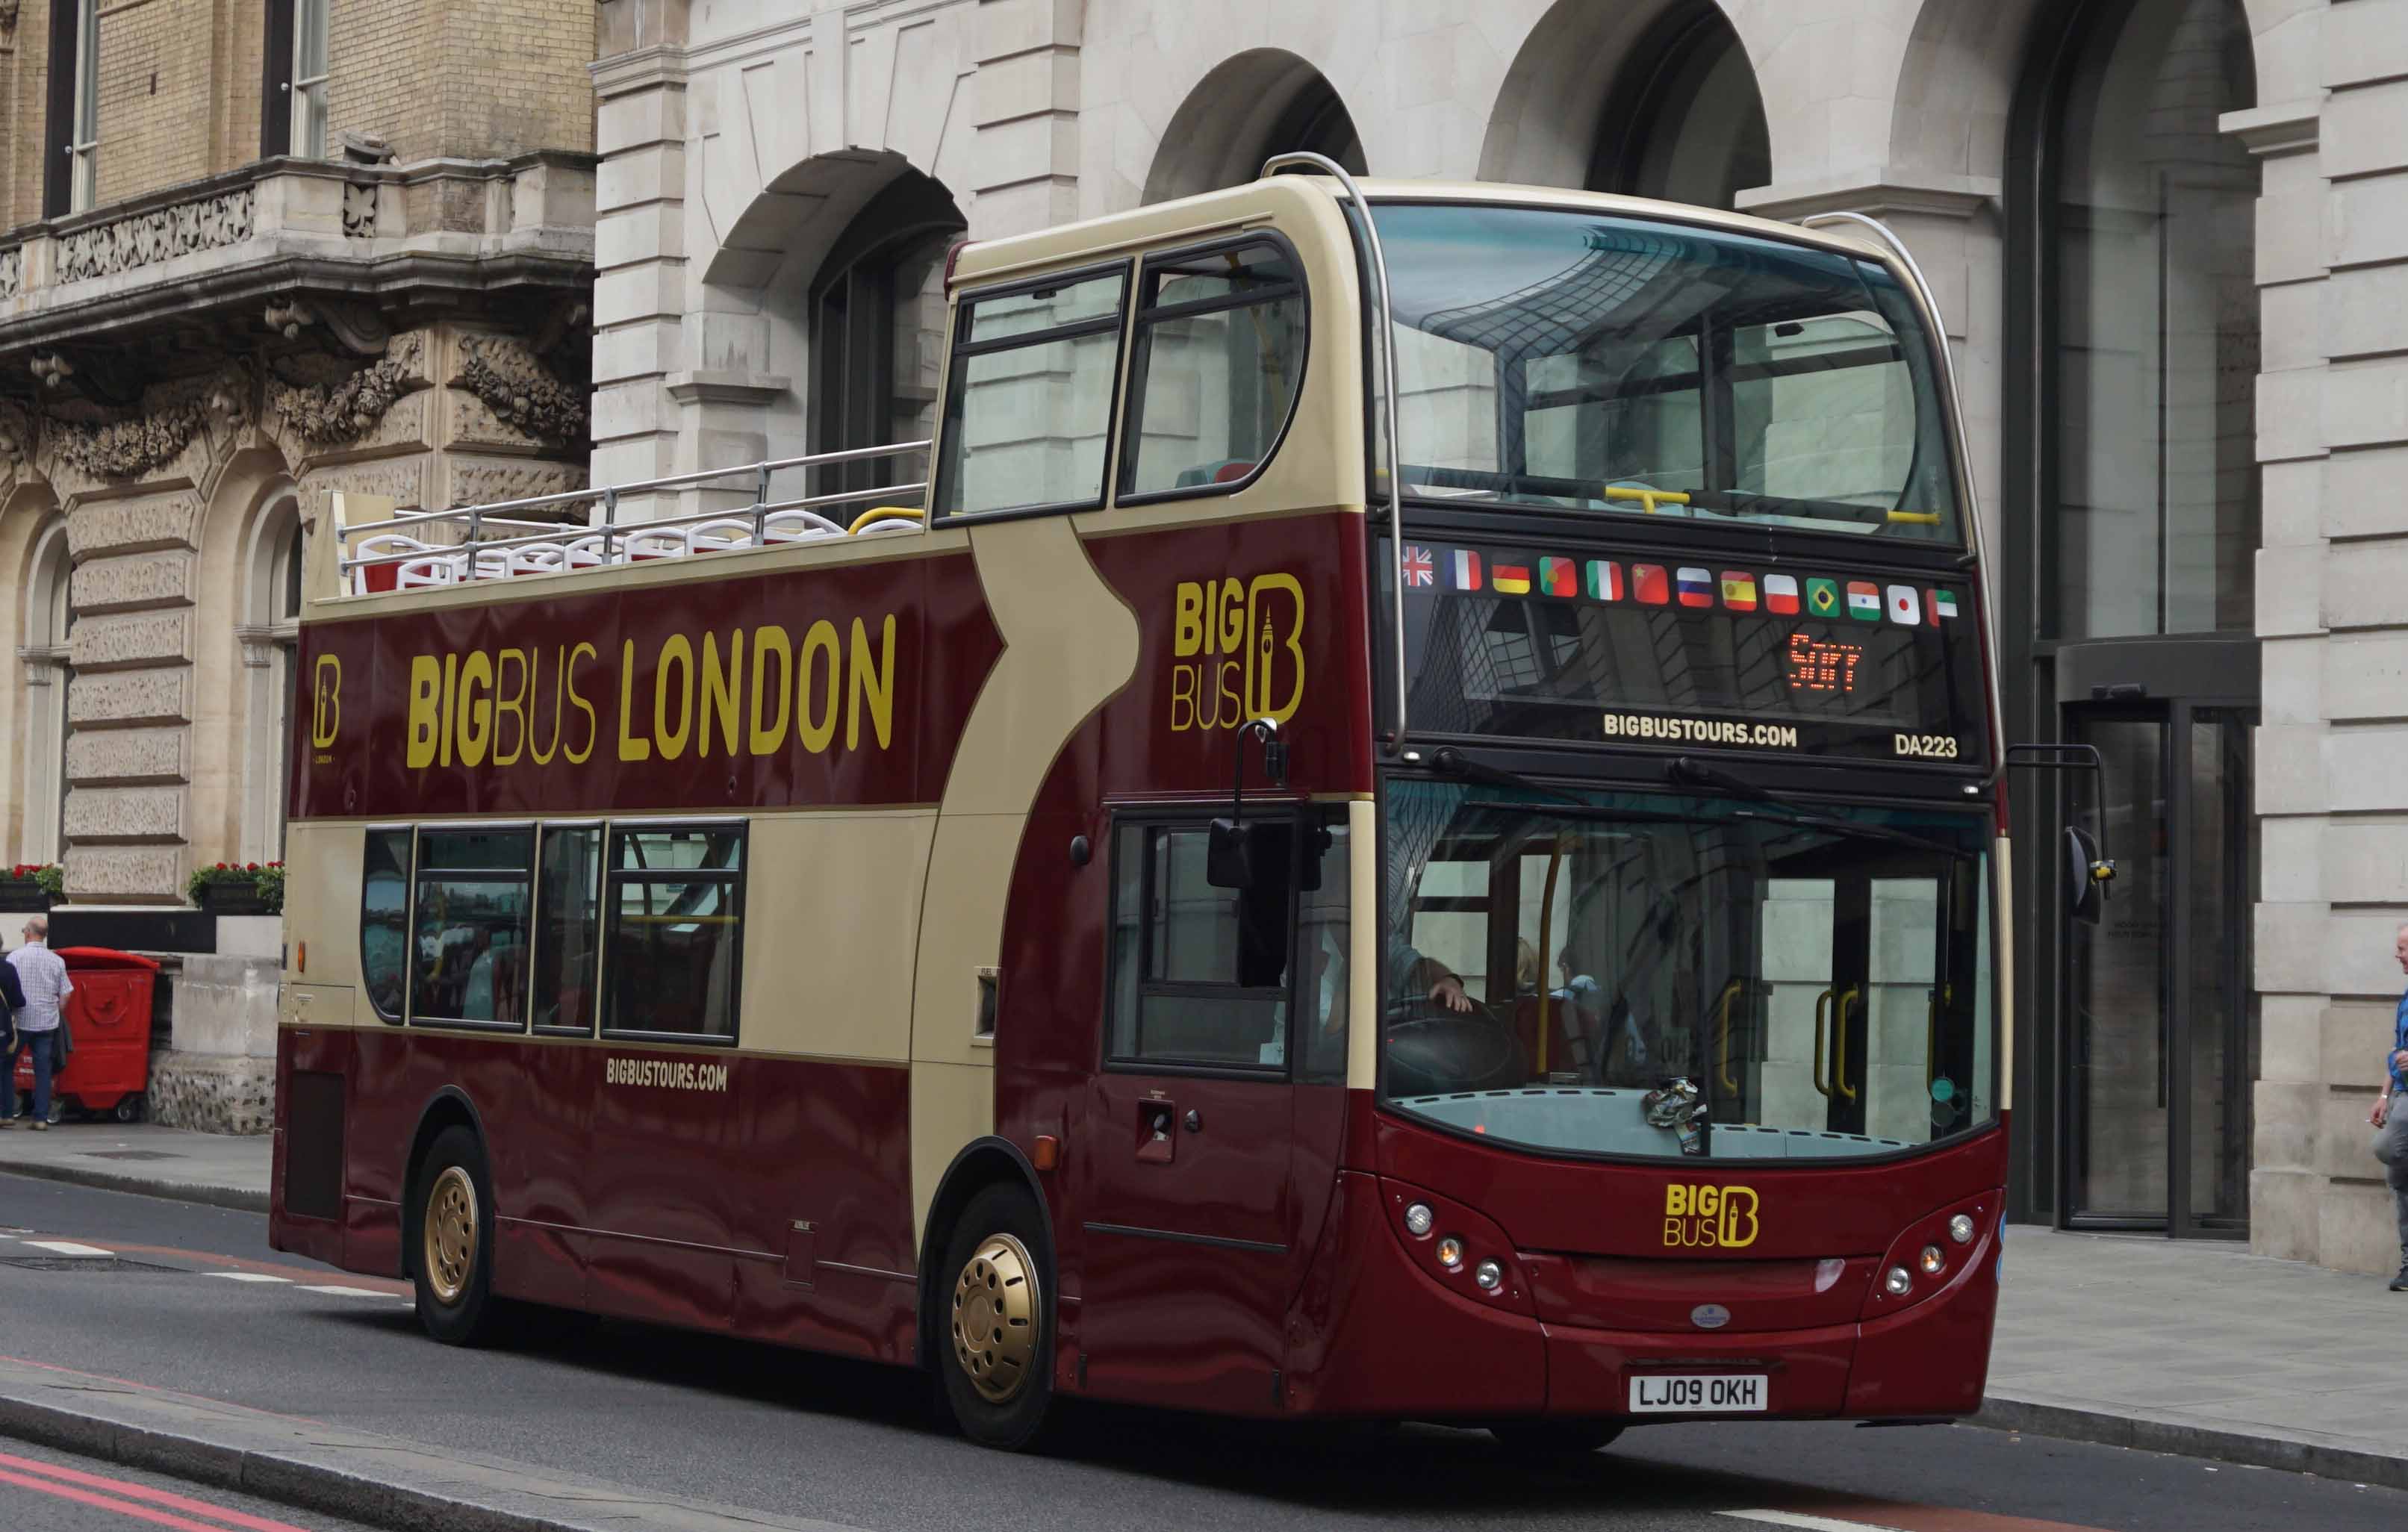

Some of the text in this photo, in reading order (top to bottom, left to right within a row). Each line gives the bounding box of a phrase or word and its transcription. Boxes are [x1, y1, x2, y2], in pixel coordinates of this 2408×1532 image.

[1175, 577, 1244, 657] BIG
[618, 613, 896, 762] LONDON
[1171, 661, 1241, 731] BUS
[1604, 714, 1797, 747] BIGBUSTOURS.COM
[1895, 734, 1958, 758] DA223
[606, 1058, 727, 1092] BIGBUSTOURS.COM
[1666, 1184, 1718, 1216] BIG
[1664, 1218, 1716, 1247] BUS
[1640, 1379, 1757, 1406] LJ09 OKH
